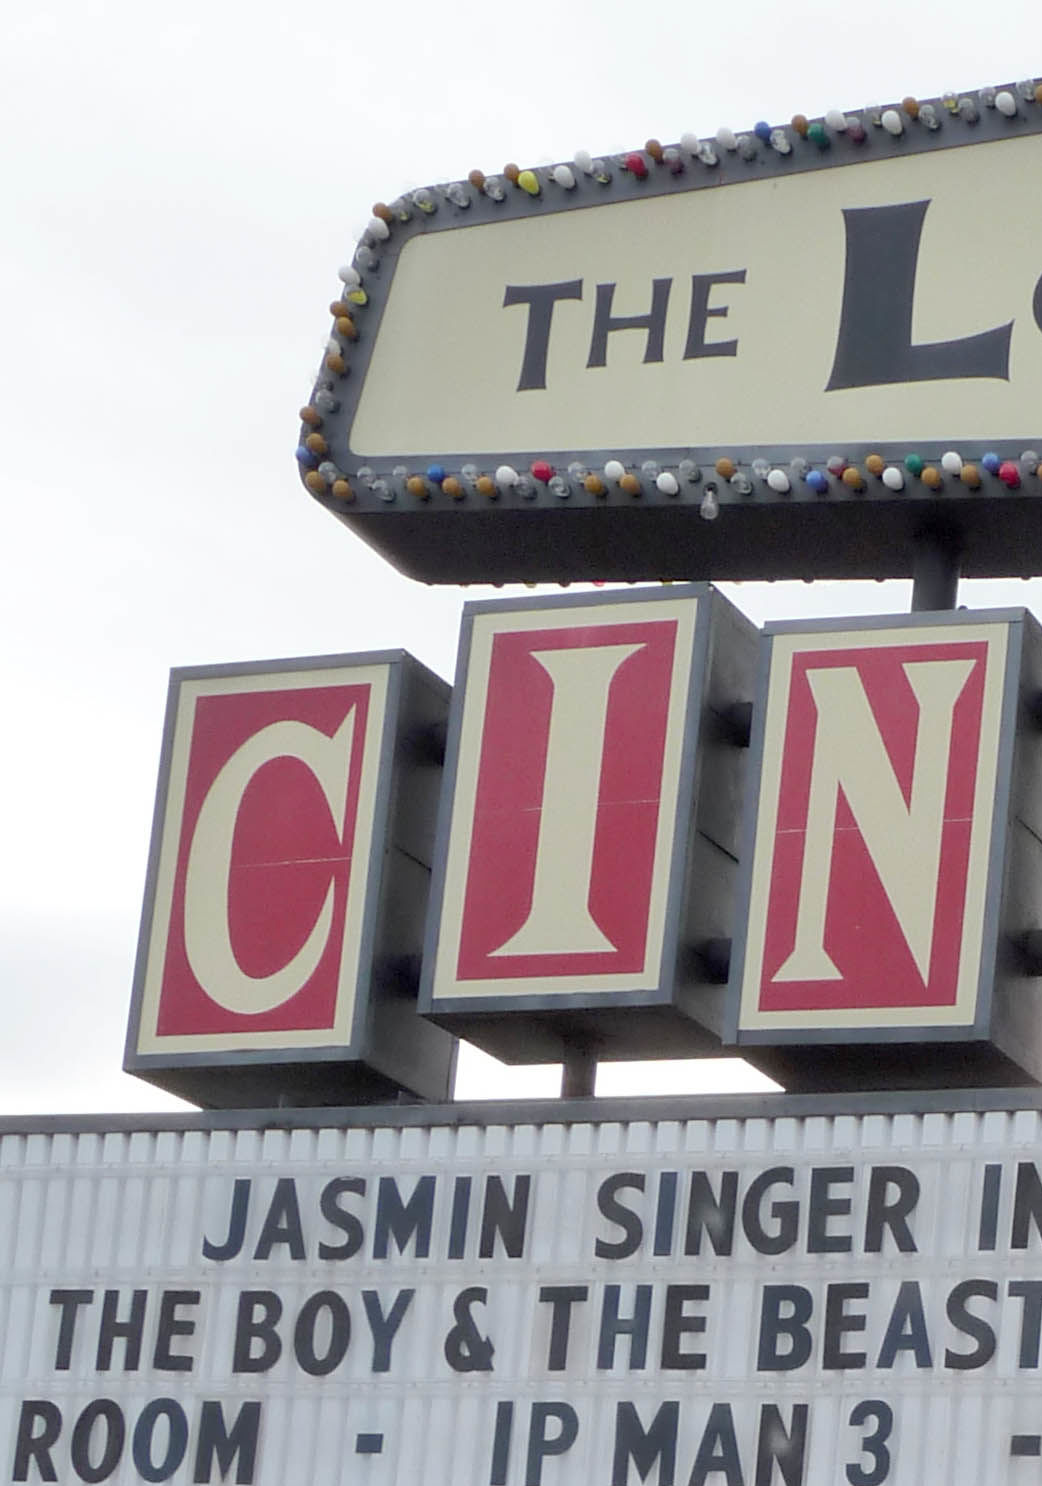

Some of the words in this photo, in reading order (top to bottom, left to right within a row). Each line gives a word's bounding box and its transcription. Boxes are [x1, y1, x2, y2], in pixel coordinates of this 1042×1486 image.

[503, 269, 747, 392] THE
[202, 1174, 532, 1262] JASMIN
[594, 1165, 921, 1261] SINGER
[49, 1288, 202, 1373] THE
[231, 1288, 416, 1377] BOY
[444, 1286, 496, 1373] &
[538, 1284, 711, 1372] THE
[11, 1397, 262, 1486] ROOM
